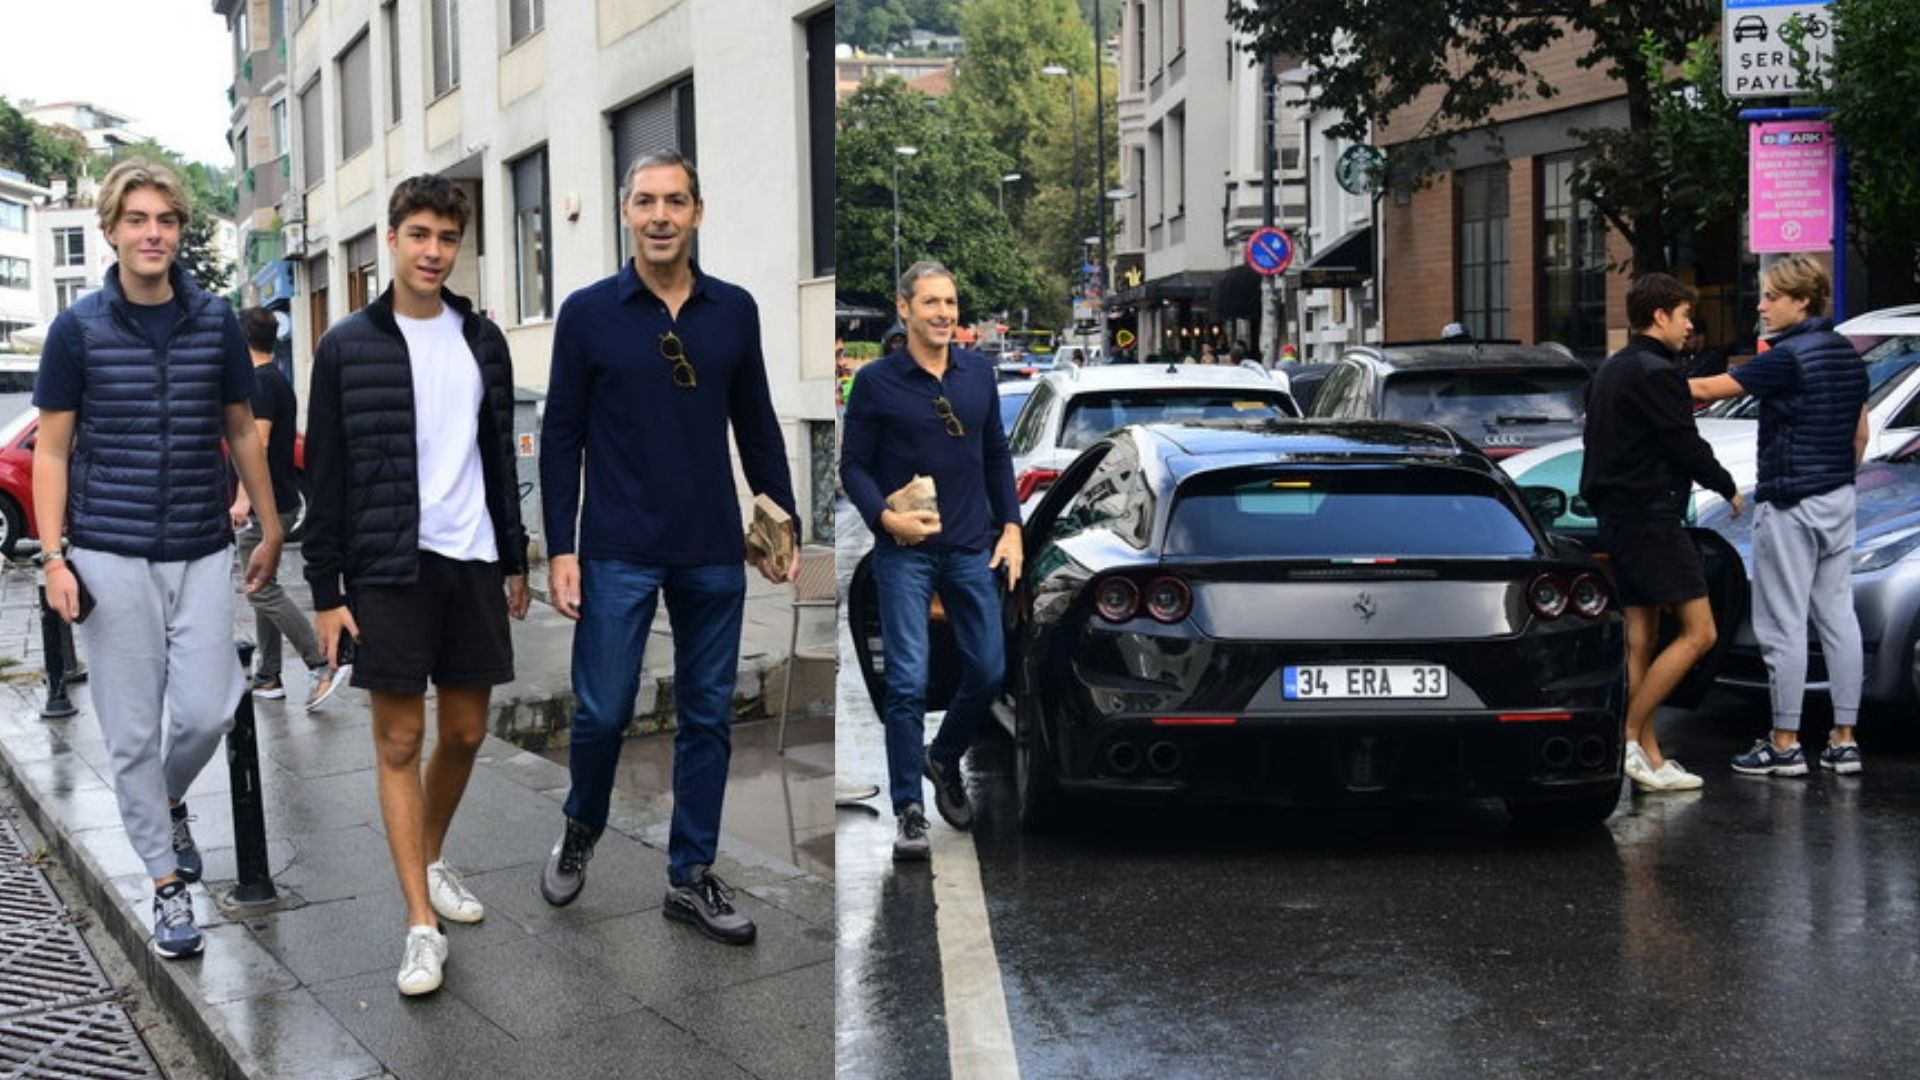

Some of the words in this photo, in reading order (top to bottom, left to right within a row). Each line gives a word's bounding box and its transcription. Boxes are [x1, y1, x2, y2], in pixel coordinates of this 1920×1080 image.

[1299, 668, 1328, 695] 34
[1346, 668, 1392, 695] ERA
[1412, 668, 1441, 694] 33
